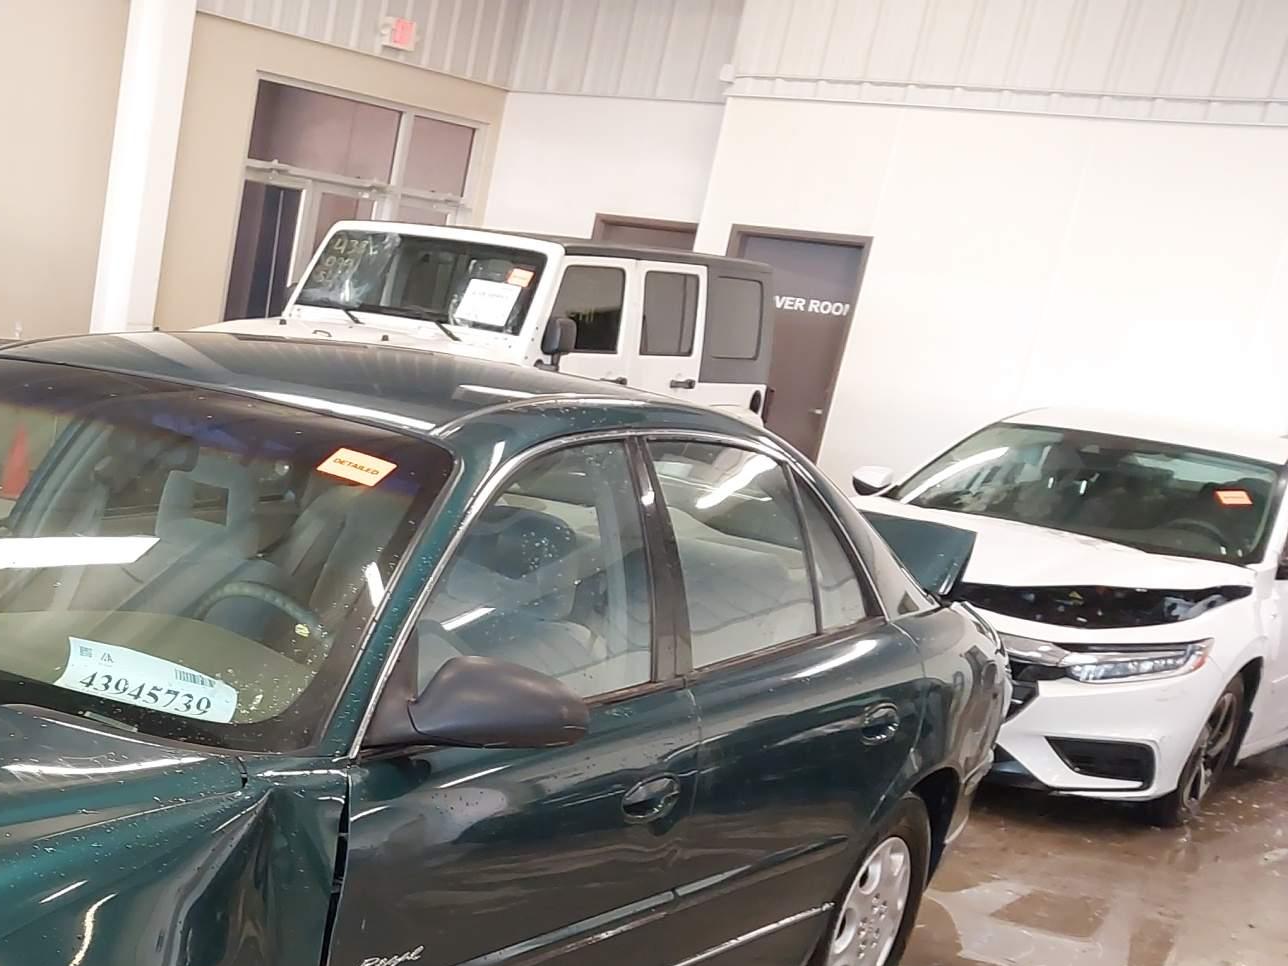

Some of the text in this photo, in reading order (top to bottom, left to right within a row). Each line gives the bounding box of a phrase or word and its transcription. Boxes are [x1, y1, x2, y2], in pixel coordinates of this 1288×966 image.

[774, 295, 806, 311] VER
[333, 457, 380, 475] DETAILED
[79, 671, 212, 716] 43945739
